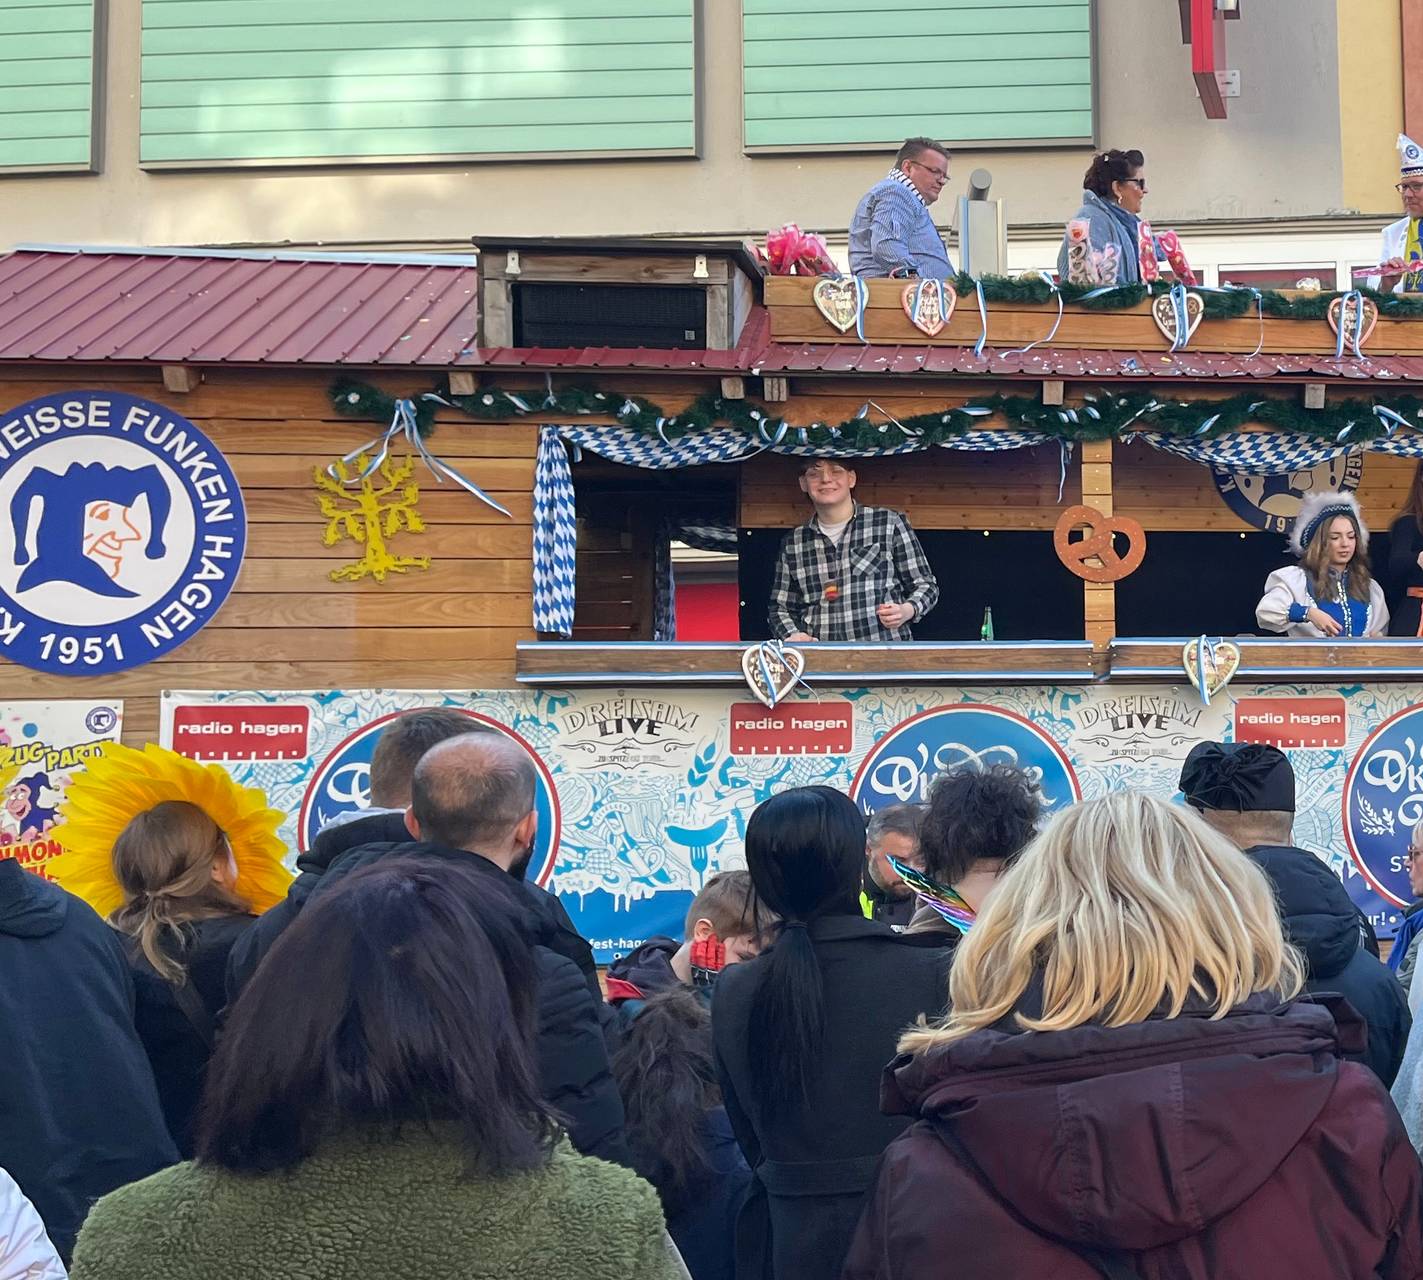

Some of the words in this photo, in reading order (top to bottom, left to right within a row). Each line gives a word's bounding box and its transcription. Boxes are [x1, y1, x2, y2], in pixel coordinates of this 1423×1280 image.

[122, 406, 234, 523] FUNKEN
[141, 534, 235, 648] HAGEN
[39, 632, 125, 665] 1951
[561, 697, 701, 735] DREISAM
[735, 717, 785, 730] radio
[791, 717, 848, 732] hagen
[1077, 694, 1203, 729] DREISAM
[1111, 713, 1170, 732] LIVE
[1239, 711, 1285, 725] radio
[1290, 712, 1342, 727] hagen
[178, 722, 235, 735] radio
[240, 721, 303, 737] hagen
[598, 717, 663, 738] LIVE
